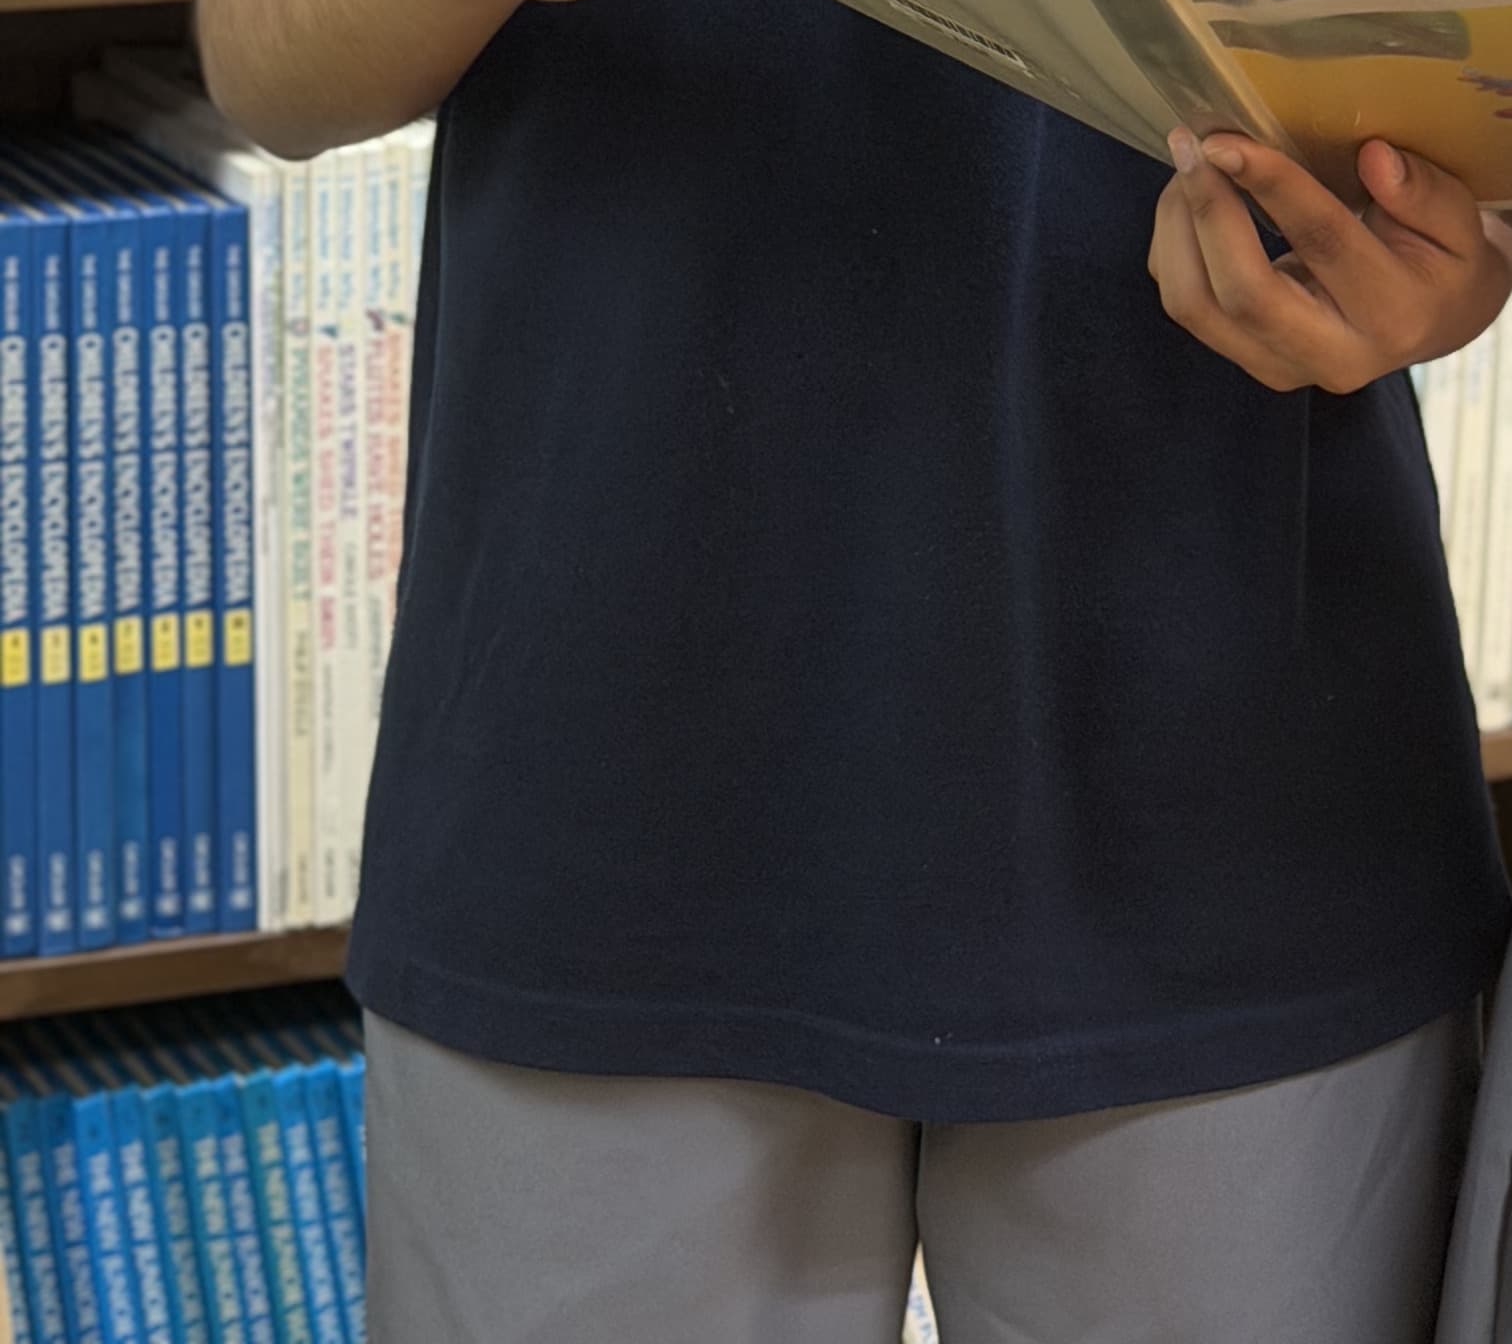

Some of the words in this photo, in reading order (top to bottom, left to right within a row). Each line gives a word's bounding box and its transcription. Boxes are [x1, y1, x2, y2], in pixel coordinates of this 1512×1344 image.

[1, 463, 27, 625] ENCYCLOPEDIA
[40, 461, 68, 623] ENCYCLOPEDIA
[77, 460, 105, 620] ENCYCLOPEDIA
[113, 453, 140, 612] ENCYCLOPEDIA
[150, 451, 178, 610] ENCYCLOPEDIA
[183, 448, 211, 608] ENCYCLOPEDIA
[222, 447, 251, 605] ENCYCLOPEDIA
